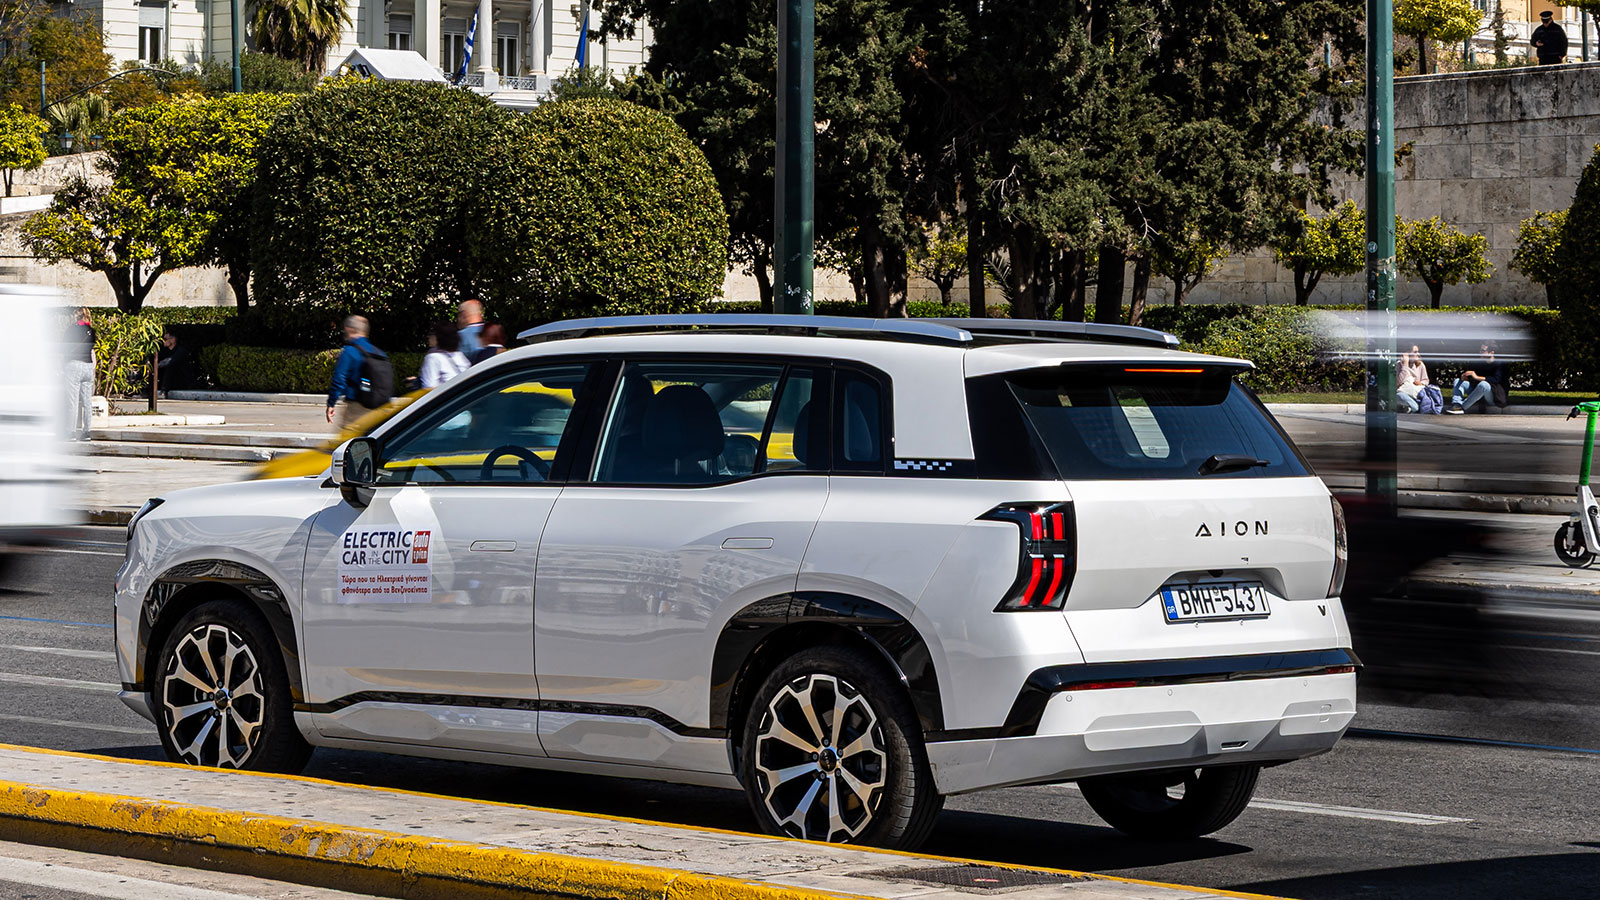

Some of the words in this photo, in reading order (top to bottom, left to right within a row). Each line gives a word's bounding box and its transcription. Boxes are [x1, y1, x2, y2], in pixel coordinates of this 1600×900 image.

[1195, 520, 1268, 537] AION
[343, 531, 413, 548] ELECTRIC
[342, 550, 367, 565] CAR
[368, 557, 381, 565] THE
[382, 550, 410, 565] CITY
[341, 575, 356, 584] Τώρα
[377, 574, 404, 584] Ηλεκτρικά
[405, 574, 428, 584] γίνονται
[341, 586, 371, 596] φθηνότερα
[372, 586, 383, 594] από
[391, 586, 428, 595] Βενζινοκίνητα
[1177, 585, 1267, 616] BMH-5431
[1318, 605, 1326, 617] V
